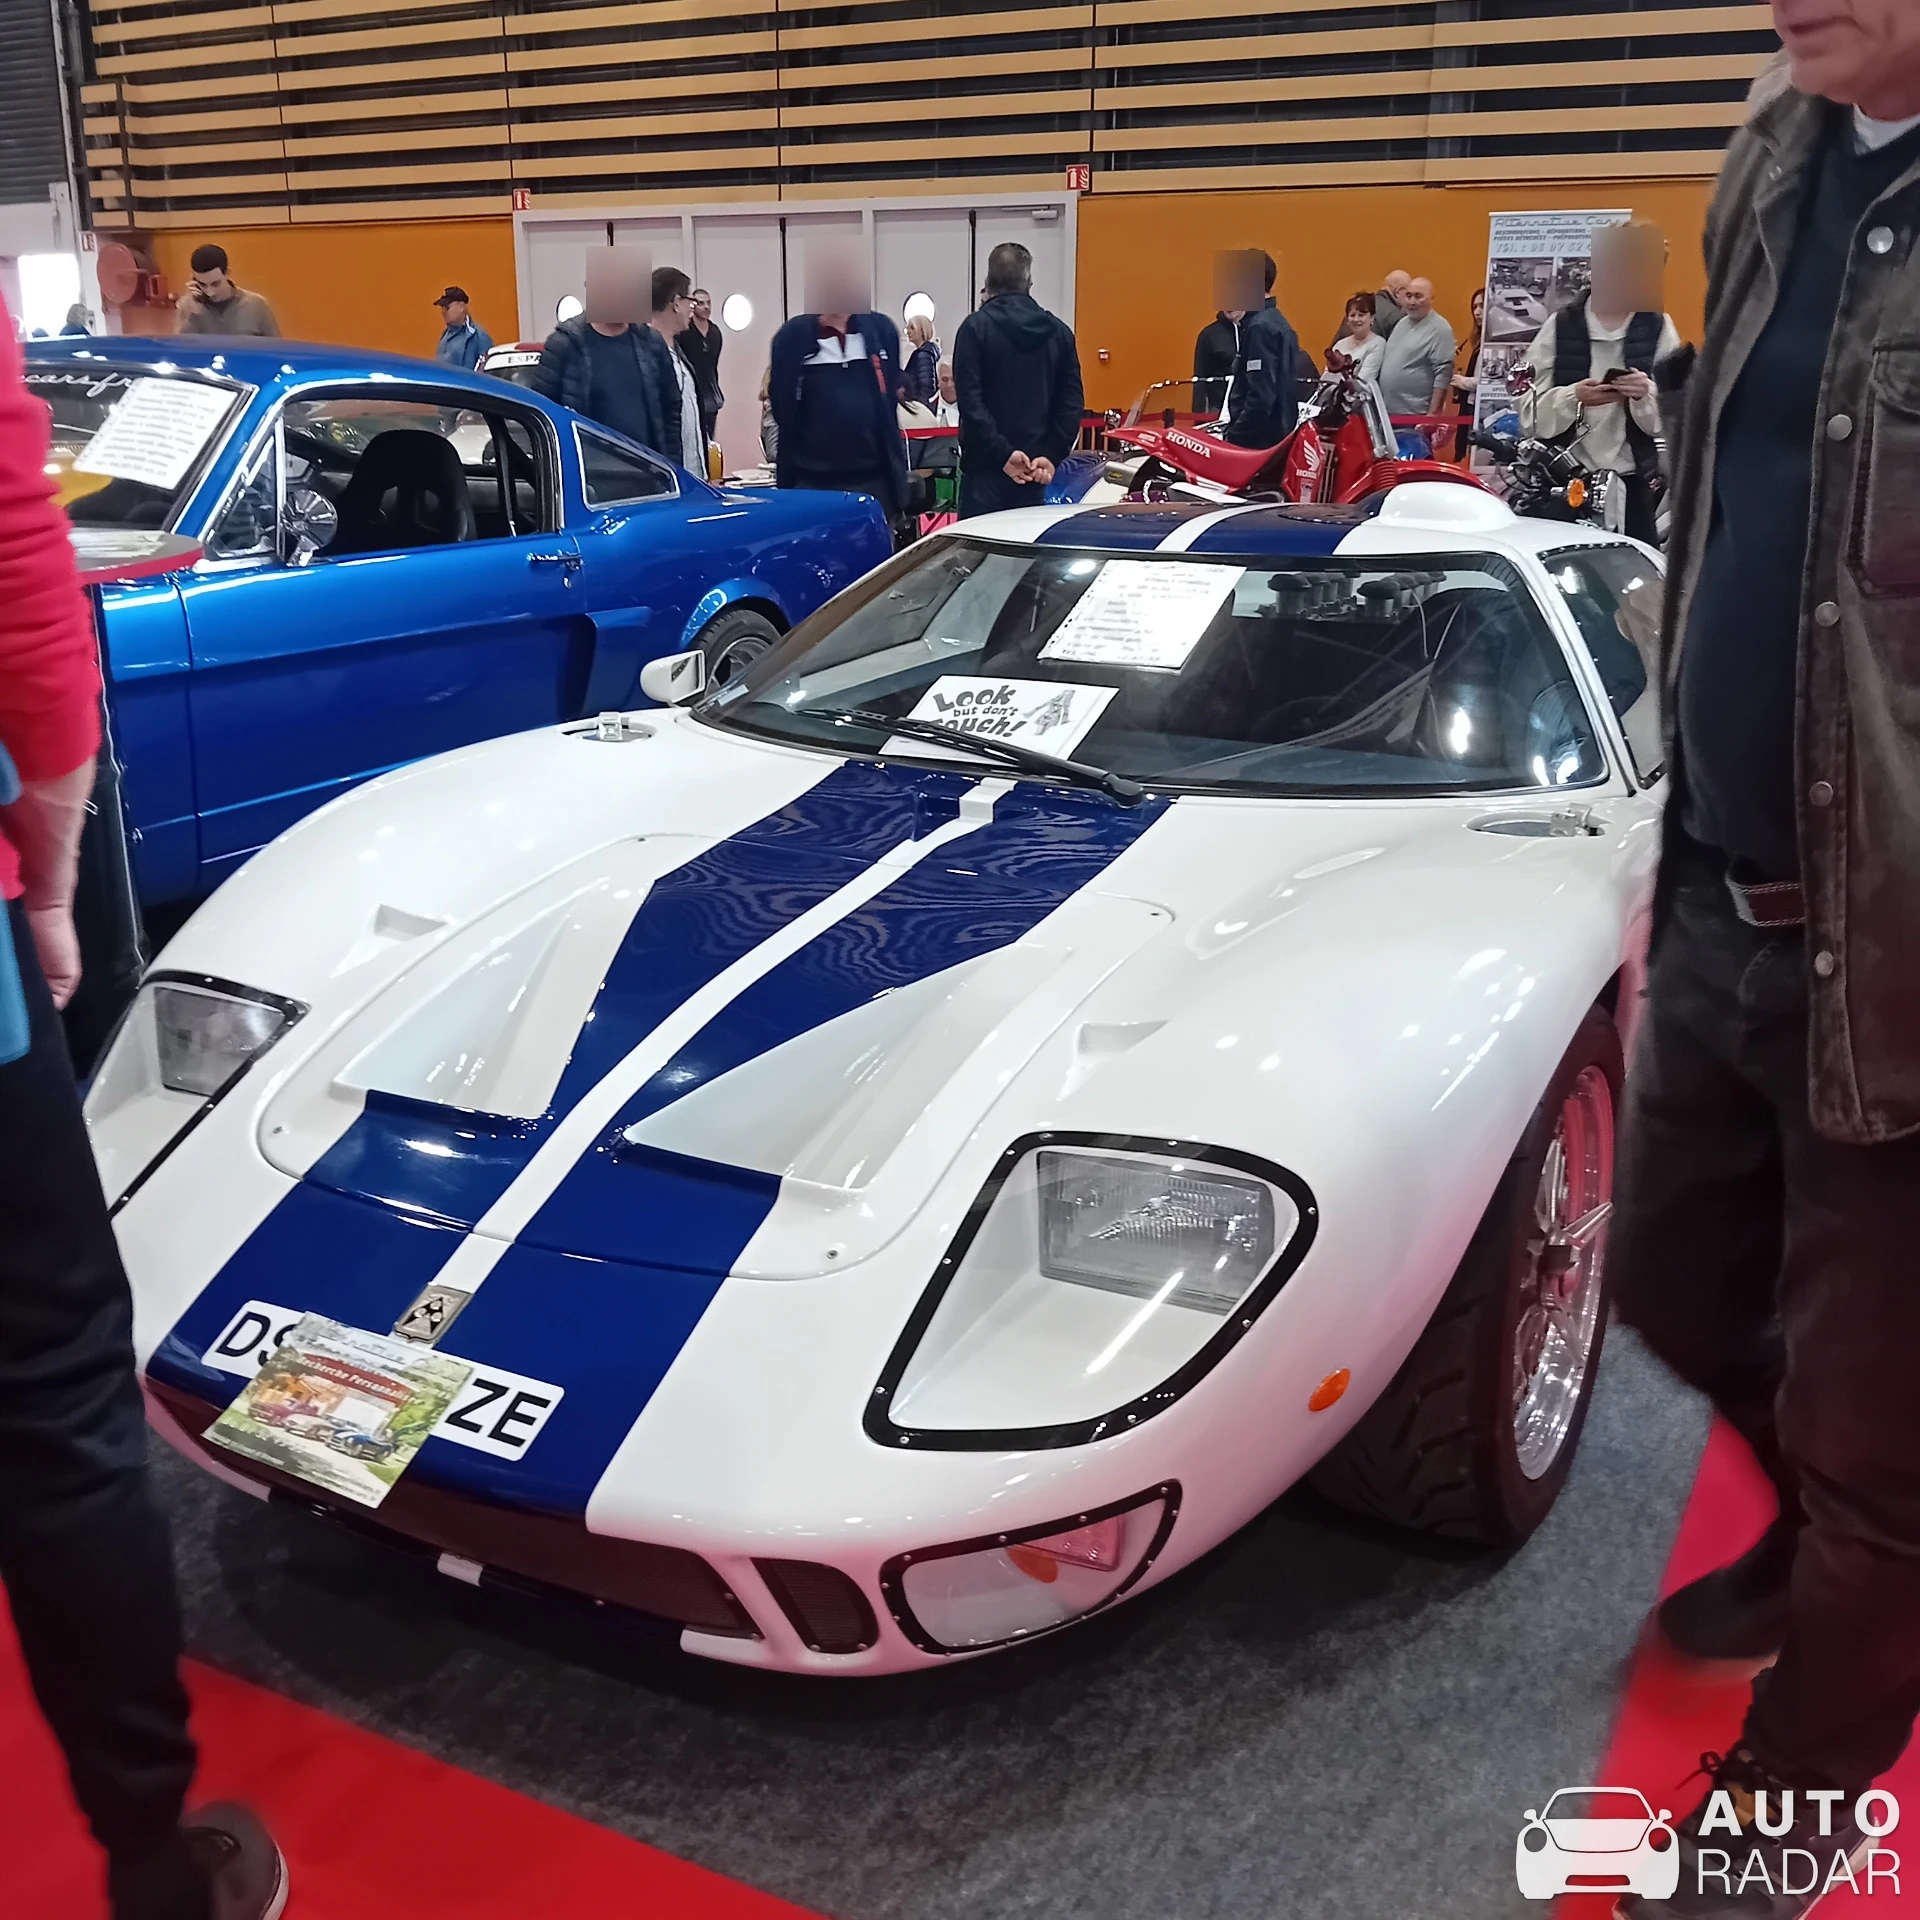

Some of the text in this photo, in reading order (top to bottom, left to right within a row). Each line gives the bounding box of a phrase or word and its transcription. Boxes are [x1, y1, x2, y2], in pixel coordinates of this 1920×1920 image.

[1495, 217, 1582, 227] Alternative
[1165, 431, 1211, 458] HONDA
[933, 684, 1016, 712] Look
[953, 705, 1018, 717] but don't
[445, 1378, 551, 1447] ZE
